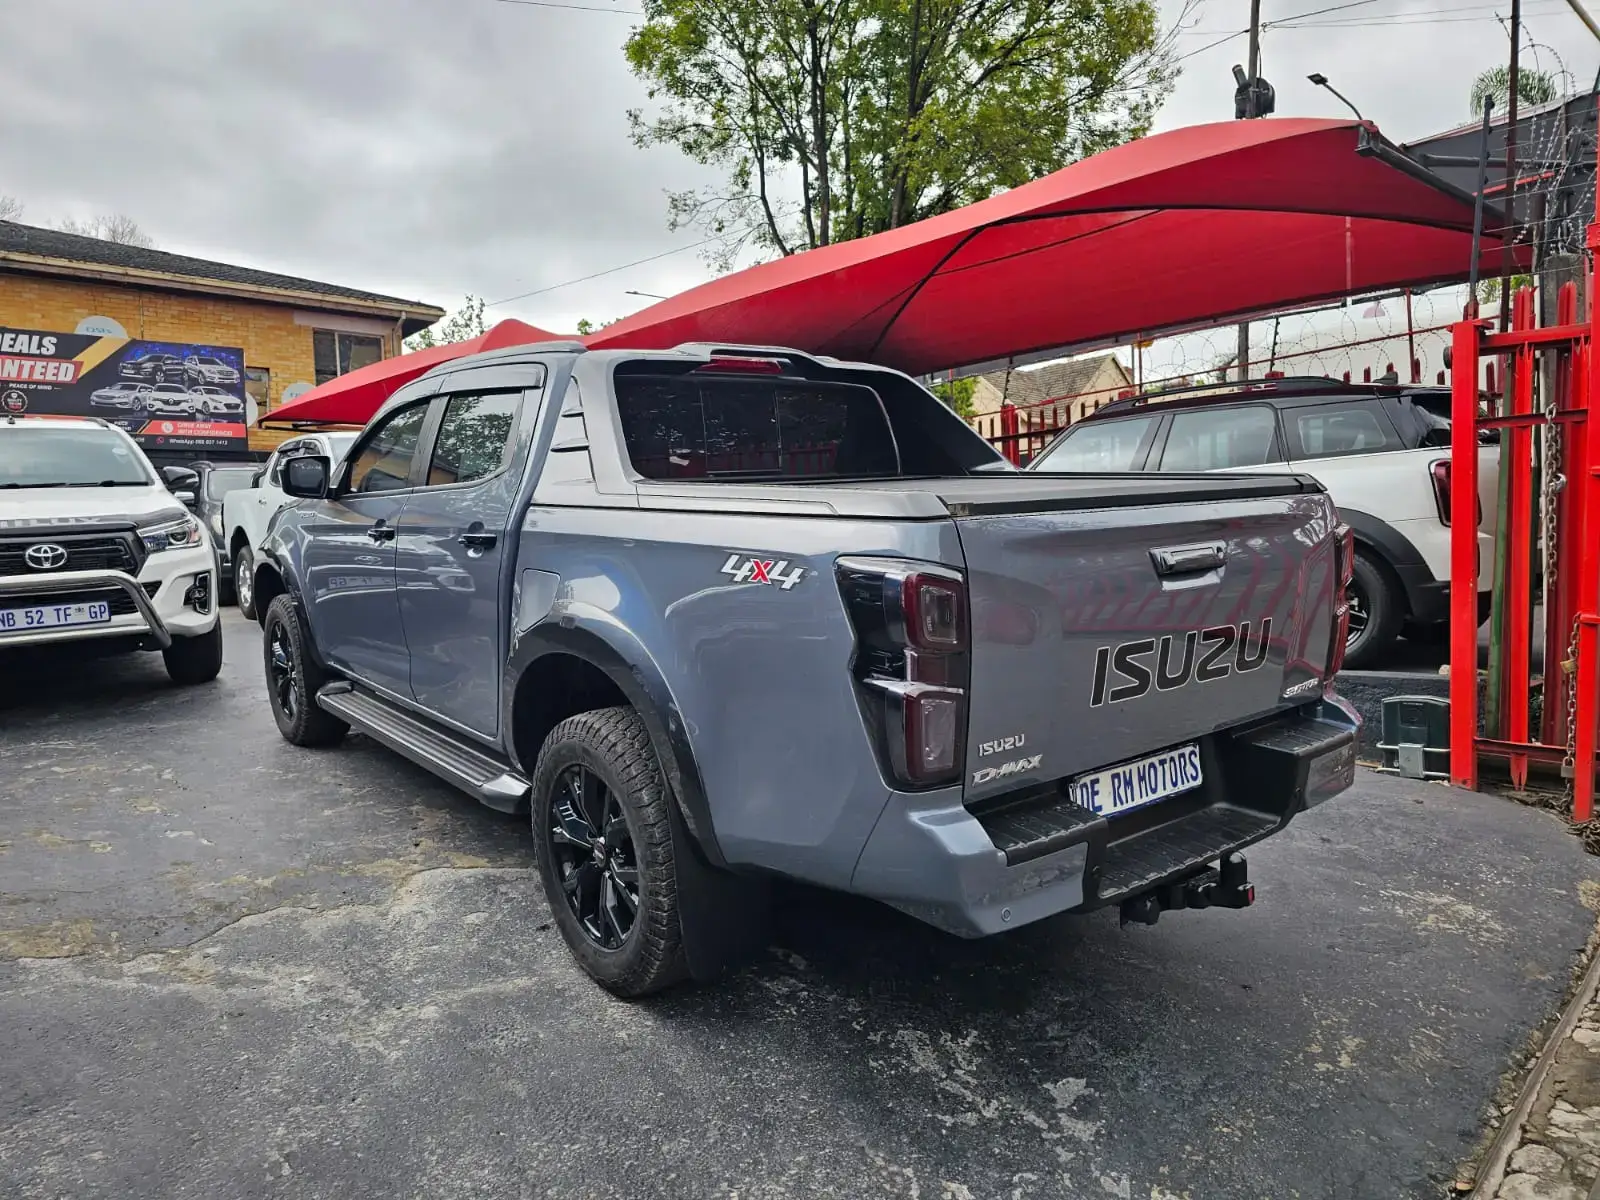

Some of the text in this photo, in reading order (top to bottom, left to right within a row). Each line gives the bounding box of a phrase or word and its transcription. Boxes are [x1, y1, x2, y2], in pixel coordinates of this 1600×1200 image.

[0, 332, 57, 356] EALS
[0, 360, 75, 382] NTEED
[24, 609, 45, 625] 52
[53, 606, 72, 623] TF
[88, 604, 107, 620] GP
[1089, 616, 1273, 708] ISUZU
[978, 733, 1025, 757] ISUZU
[1110, 768, 1136, 808] RM
[1137, 749, 1200, 800] MOTORS
